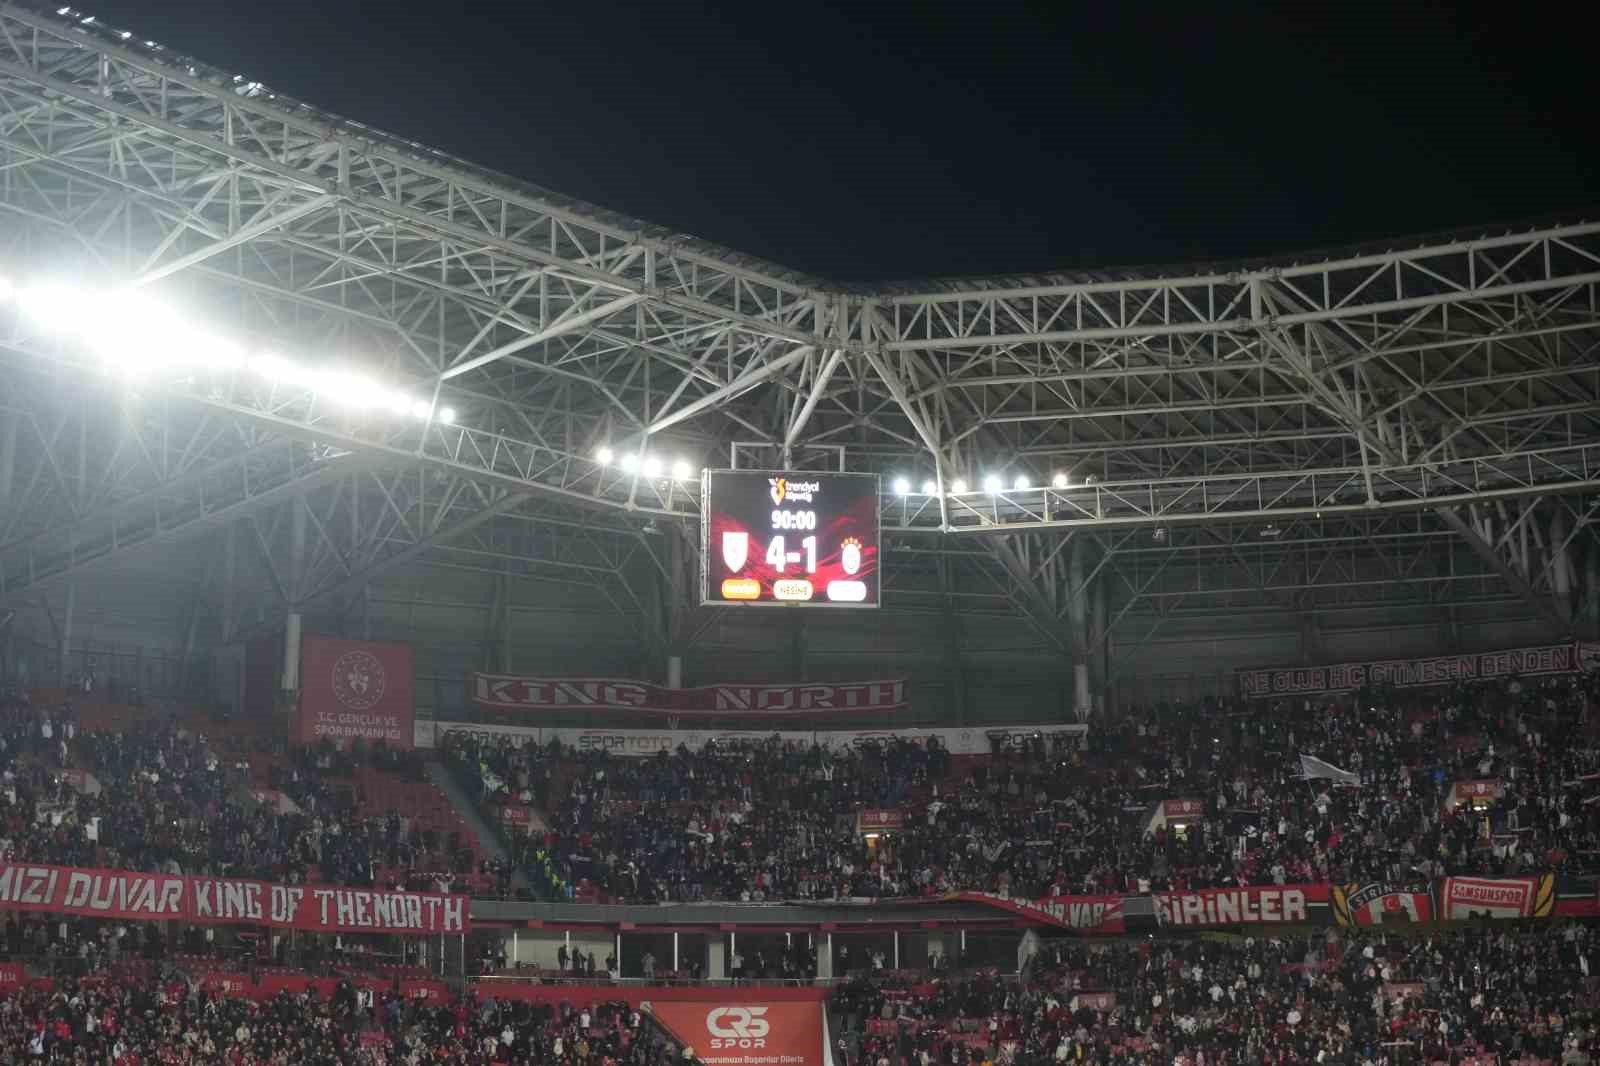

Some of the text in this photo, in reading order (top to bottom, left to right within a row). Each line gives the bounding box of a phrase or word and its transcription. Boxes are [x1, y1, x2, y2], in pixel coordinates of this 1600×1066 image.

[771, 510, 816, 530] 90:00
[477, 677, 901, 711] KING NORTH
[64, 871, 184, 913] DUVAR
[194, 879, 263, 920] KING
[271, 885, 303, 923] OF
[706, 1006, 770, 1038] CRS
[711, 1039, 766, 1048] SPOR
